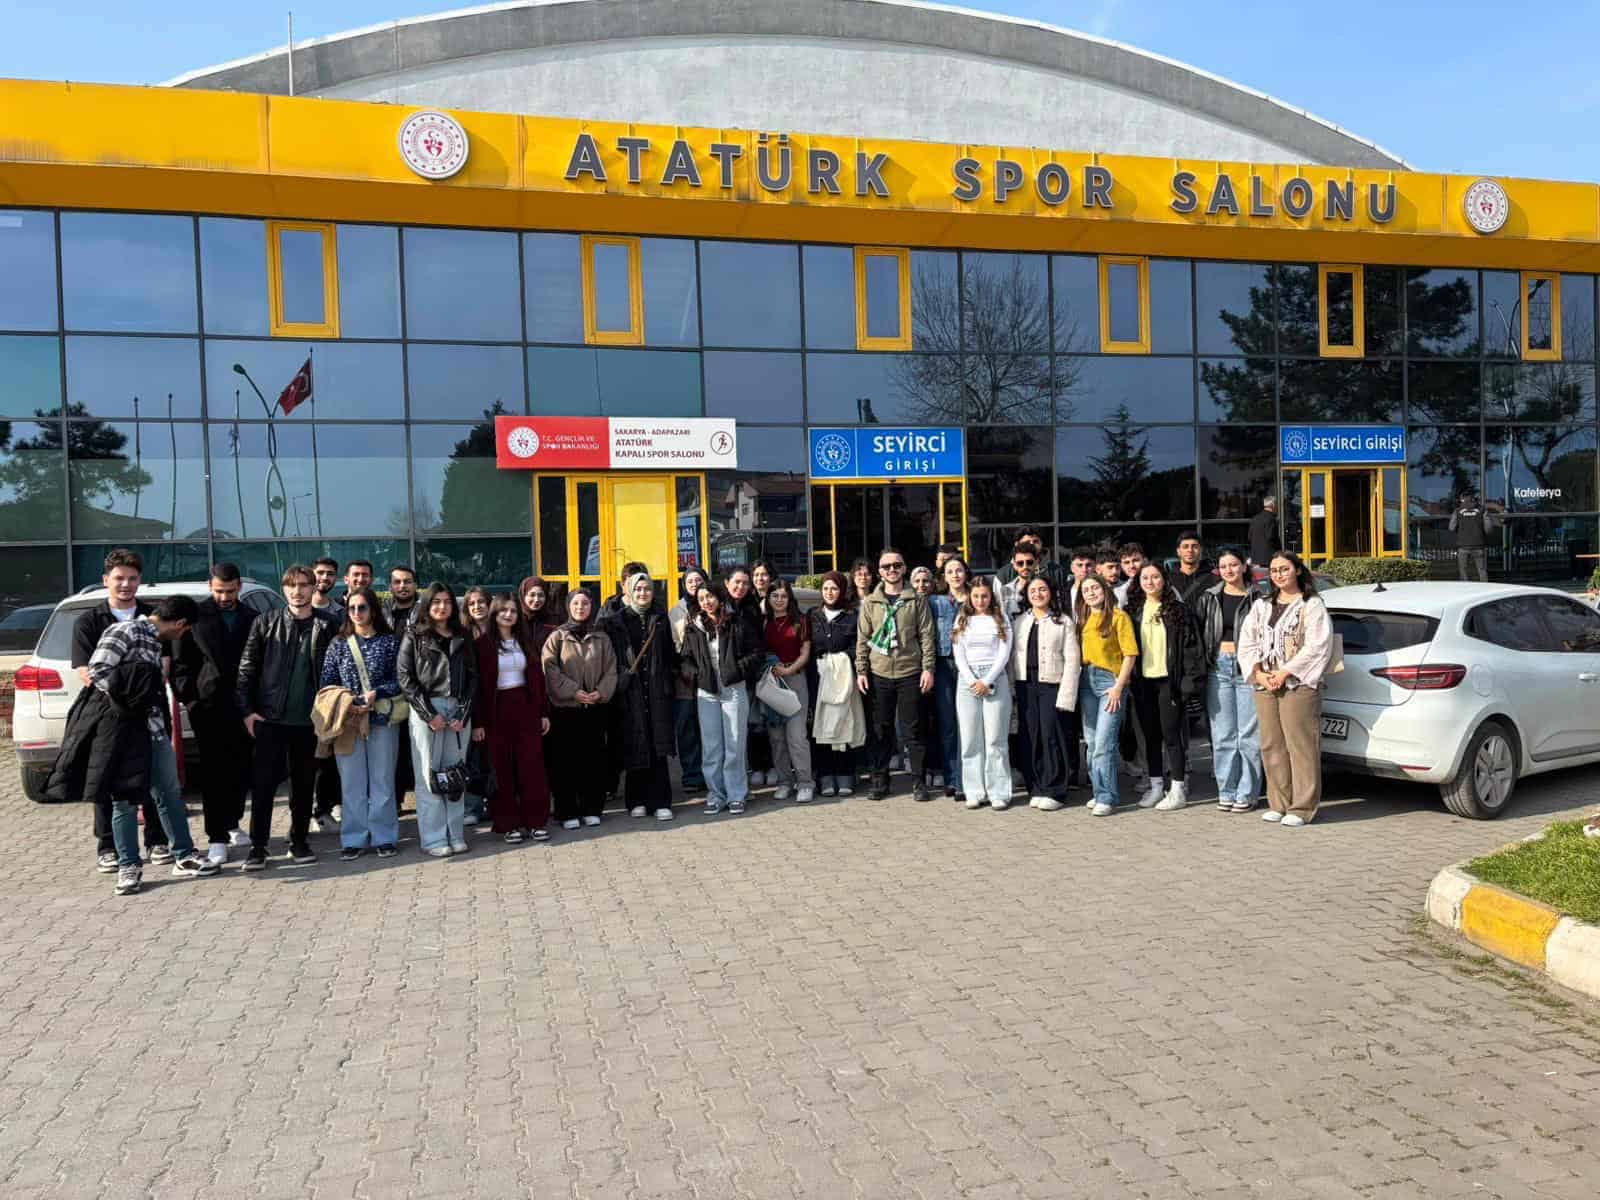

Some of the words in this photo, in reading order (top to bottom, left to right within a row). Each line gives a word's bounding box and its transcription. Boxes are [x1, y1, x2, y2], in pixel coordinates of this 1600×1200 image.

[564, 132, 890, 196] ATATÜRK
[951, 157, 1114, 209] SPOR
[1170, 170, 1397, 223] SALONU
[614, 428, 647, 436] SAKARYA
[615, 438, 653, 447] ATATÜRK
[873, 432, 946, 453] SEYİRCİ
[1313, 434, 1361, 450] SEYİRCİ
[1365, 433, 1402, 453] GİRİŞİ
[615, 450, 646, 458] KAPALI
[647, 450, 670, 459] SPOR
[671, 450, 705, 459] SALONU
[884, 457, 936, 472] GİRİŞİ
[1513, 487, 1562, 499] Kafeterya
[1323, 719, 1345, 734] 722
